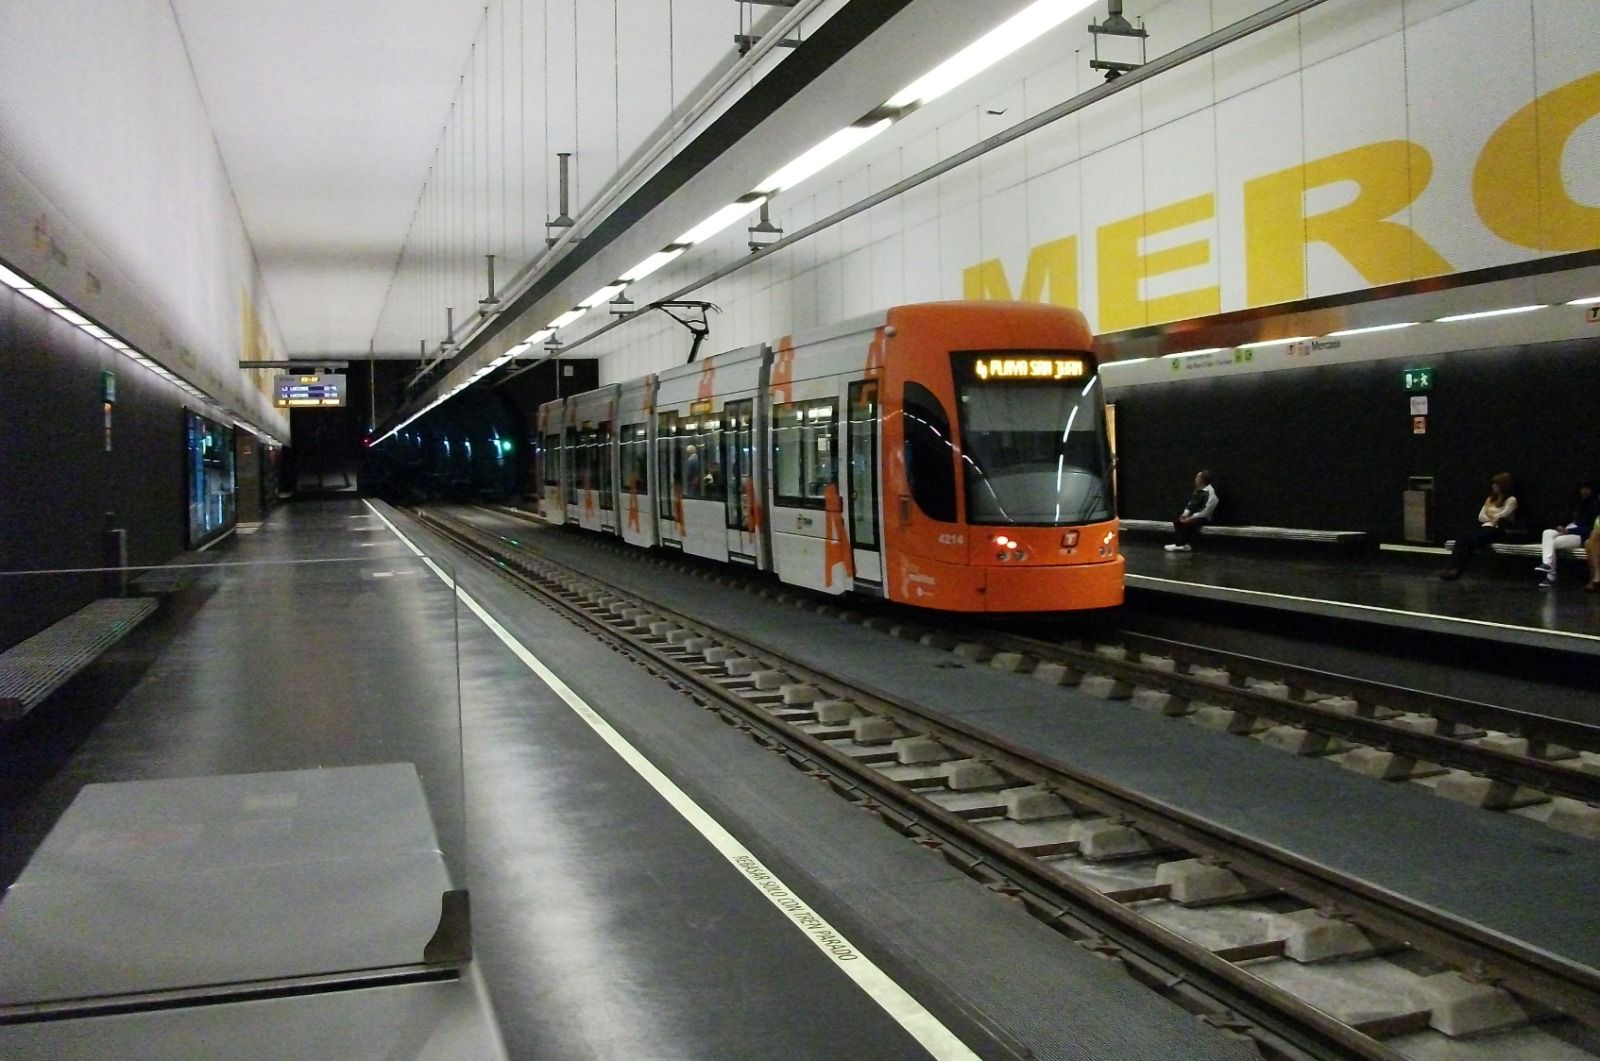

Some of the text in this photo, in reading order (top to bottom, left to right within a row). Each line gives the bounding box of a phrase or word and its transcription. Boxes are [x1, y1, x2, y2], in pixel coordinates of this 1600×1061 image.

[989, 359, 1028, 377] PLAYA
[1029, 360, 1053, 377] SAN
[1054, 360, 1083, 380] JUAN
[777, 897, 804, 912] CON
[793, 911, 825, 930] TREN
[812, 930, 858, 961] PARADO
